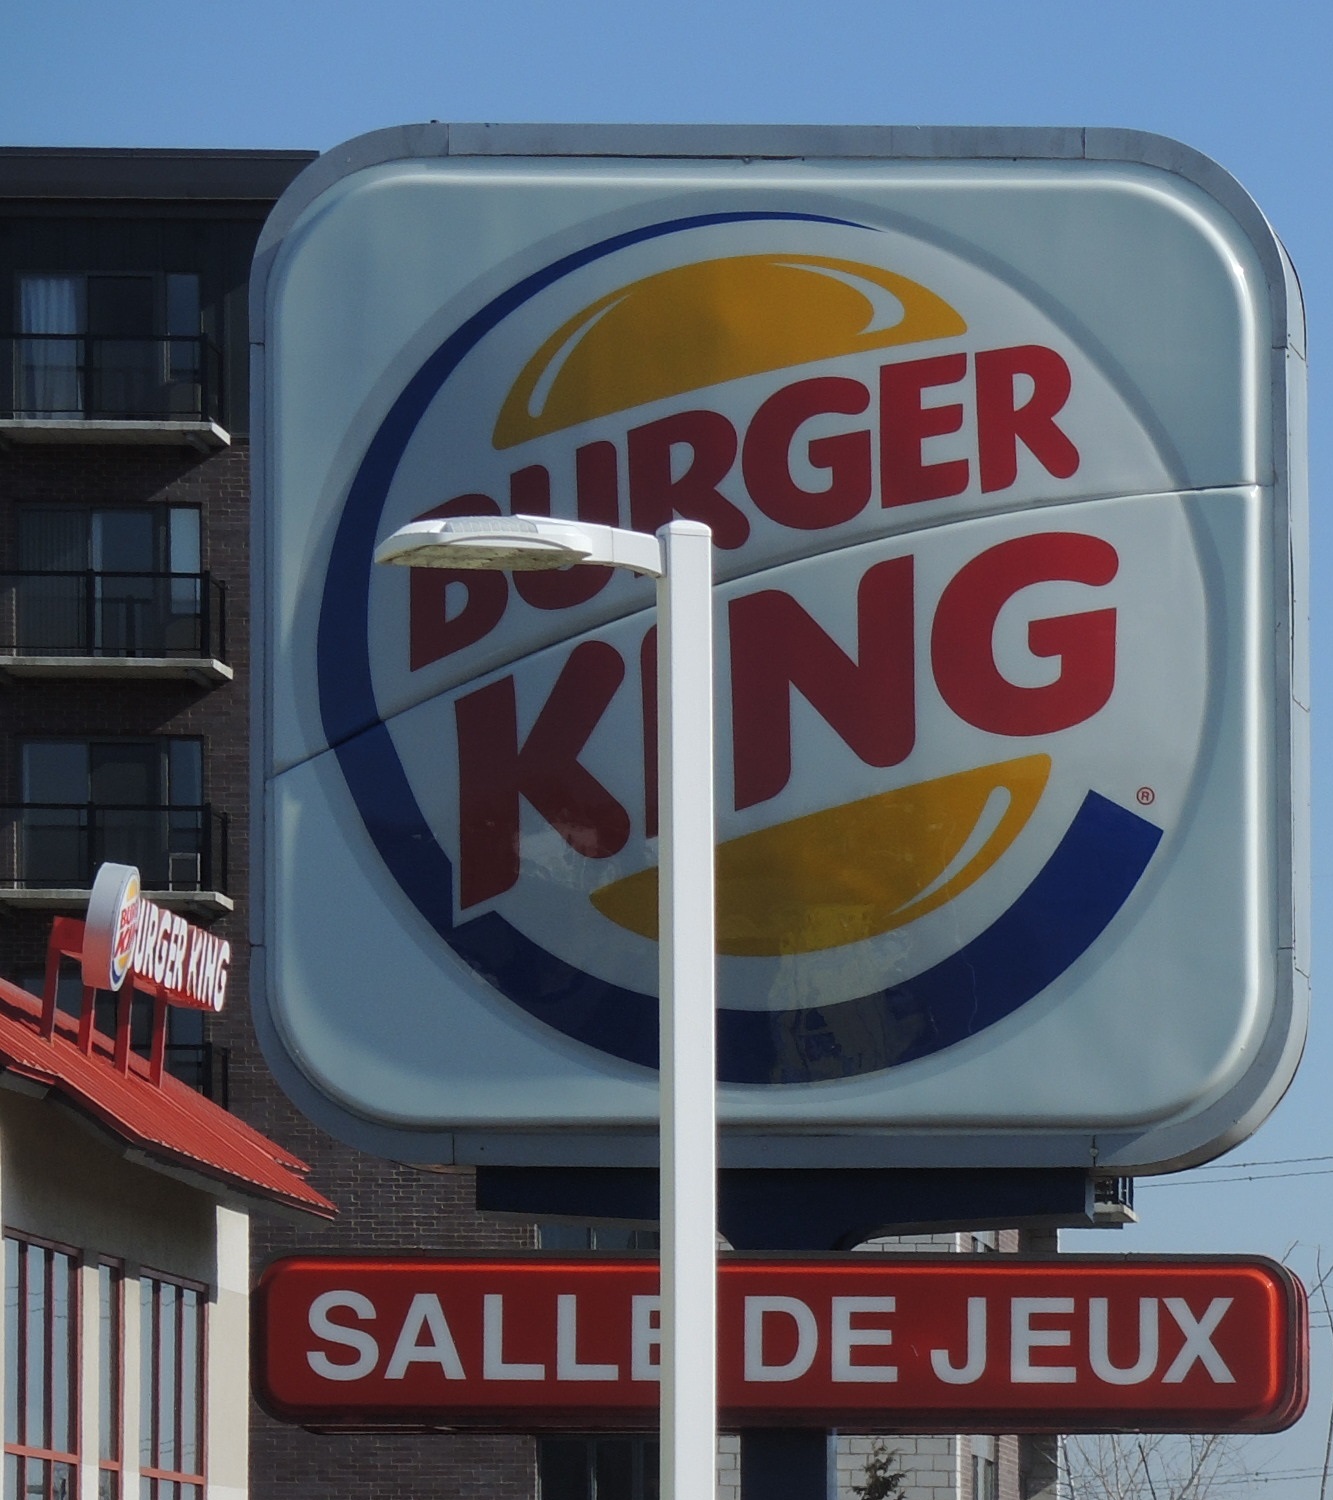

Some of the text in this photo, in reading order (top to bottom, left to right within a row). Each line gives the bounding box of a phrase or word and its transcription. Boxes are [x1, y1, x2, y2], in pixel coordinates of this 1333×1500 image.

[410, 344, 1080, 672] BURGER
[453, 531, 1119, 910] KNG
[127, 897, 231, 1013] URGER KING
[743, 1295, 898, 1383] DE
[930, 1297, 1237, 1385] JEUX
